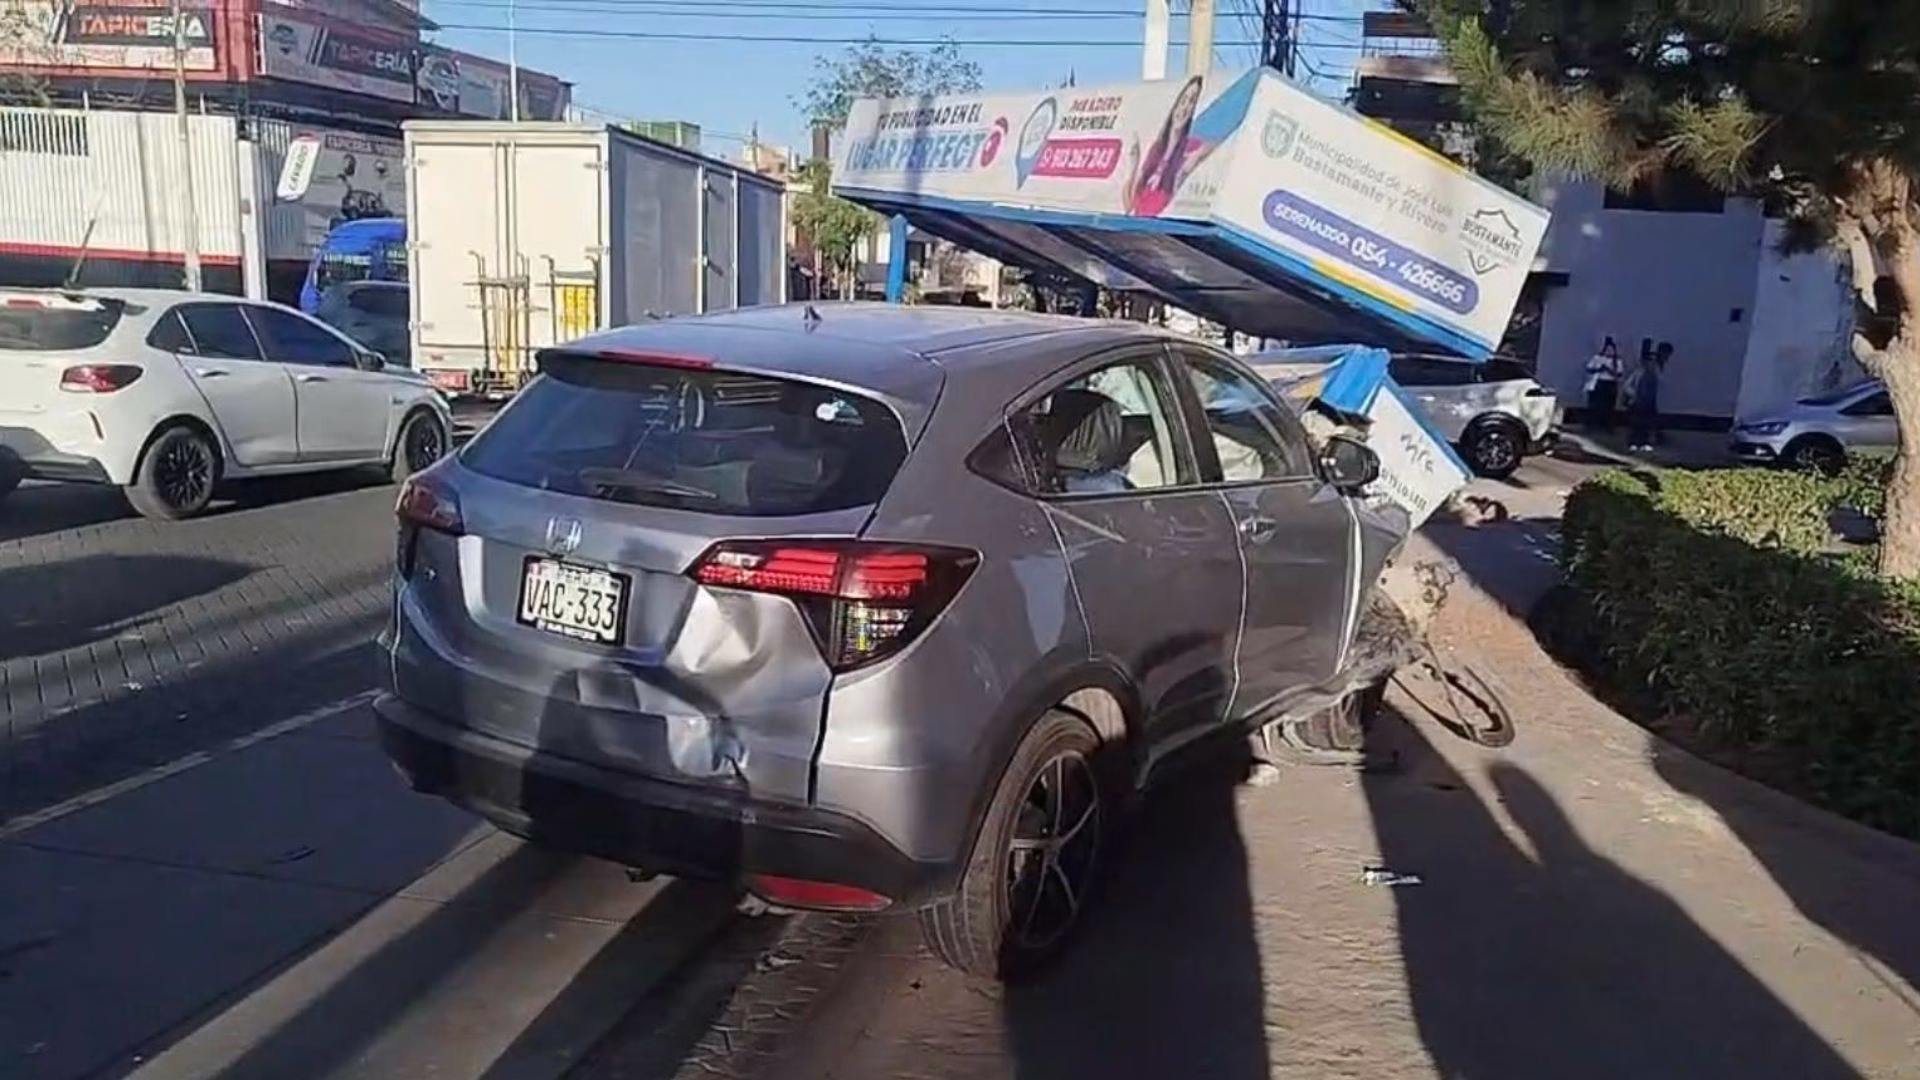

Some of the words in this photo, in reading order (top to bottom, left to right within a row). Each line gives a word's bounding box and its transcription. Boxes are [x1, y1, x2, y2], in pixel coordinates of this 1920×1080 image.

[1350, 236, 1387, 268] 054
[1397, 257, 1467, 304] 426666
[526, 576, 618, 632] VAC-333
